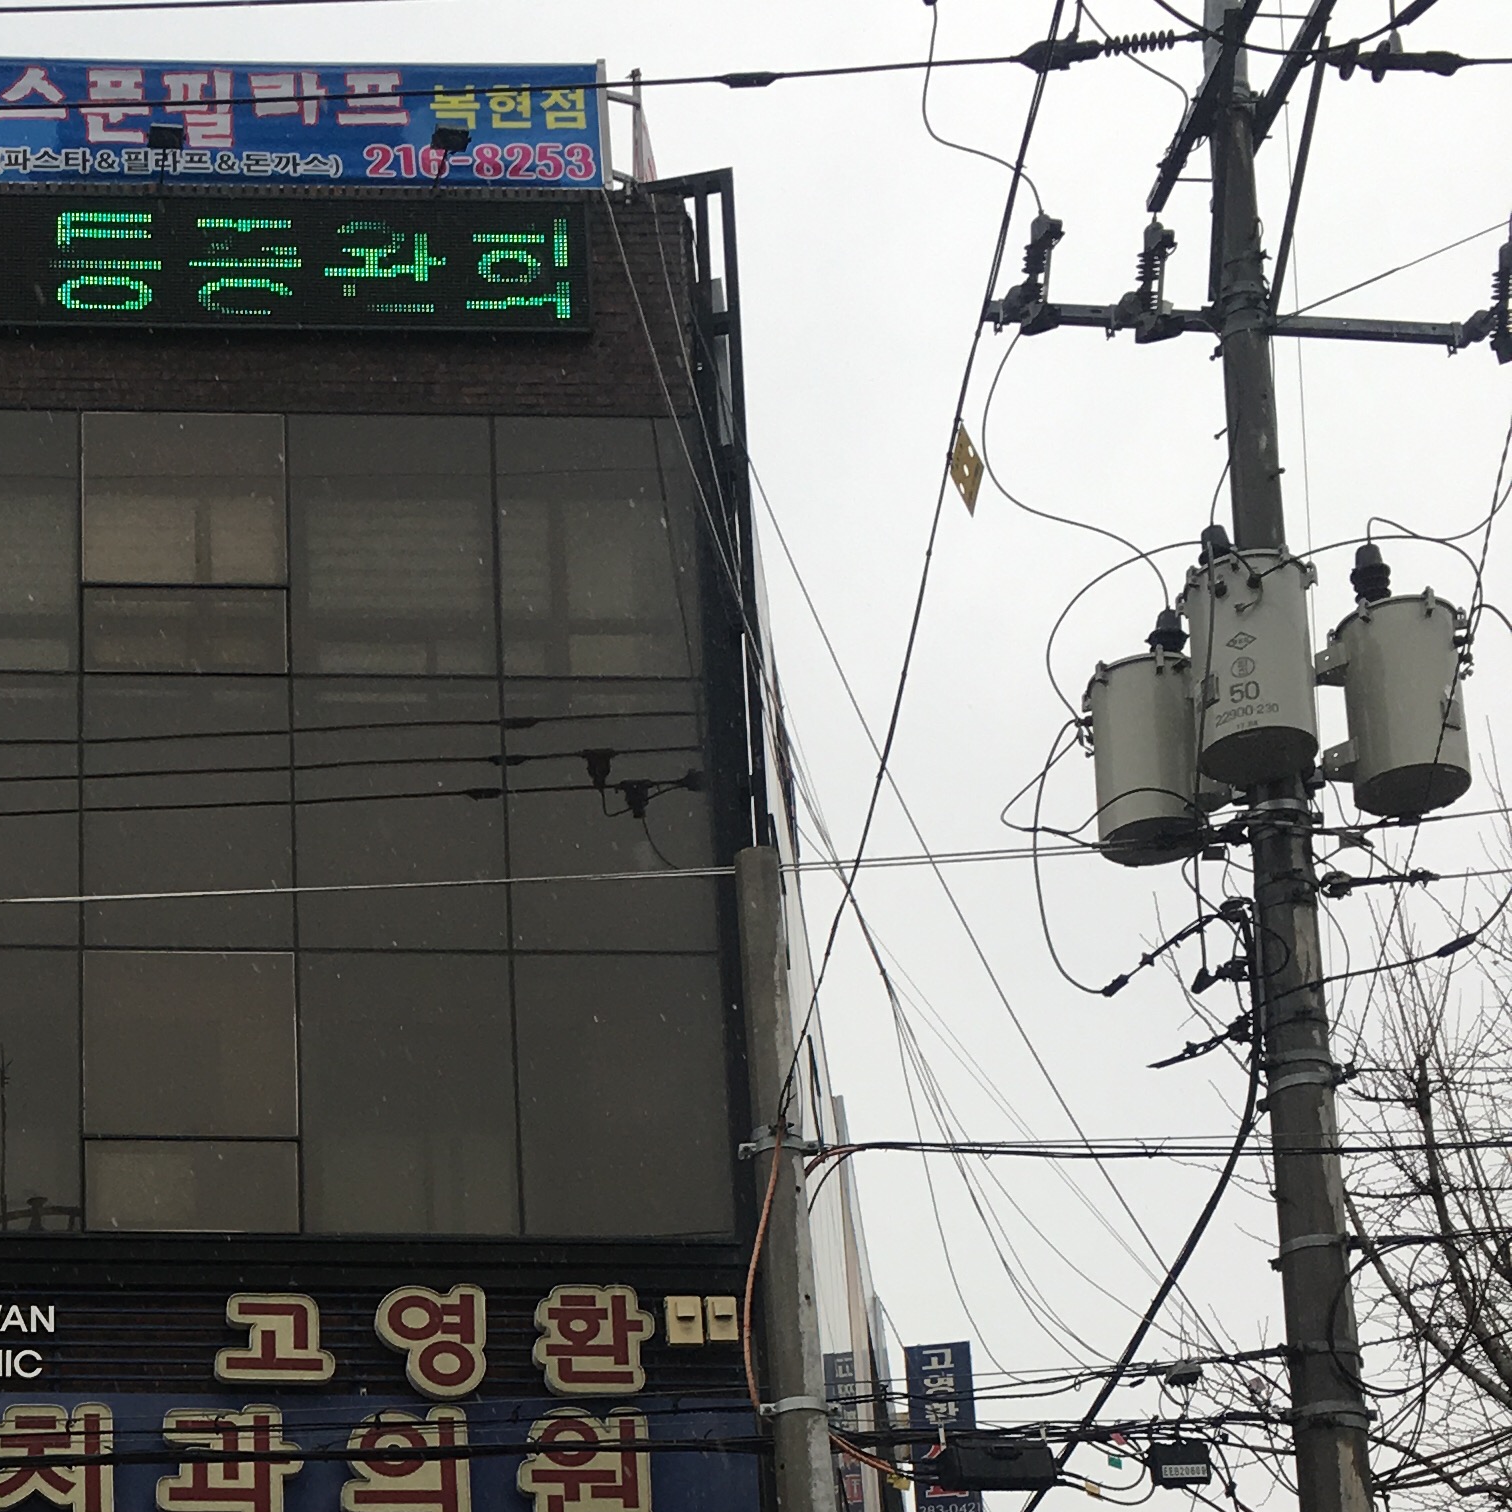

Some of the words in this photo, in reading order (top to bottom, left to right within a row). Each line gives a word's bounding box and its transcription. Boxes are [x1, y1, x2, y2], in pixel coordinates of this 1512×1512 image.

[429, 84, 589, 130] 복현점
[363, 142, 596, 181] 216-8253
[1230, 680, 1261, 704] 50
[214, 1284, 654, 1396] 고영환
